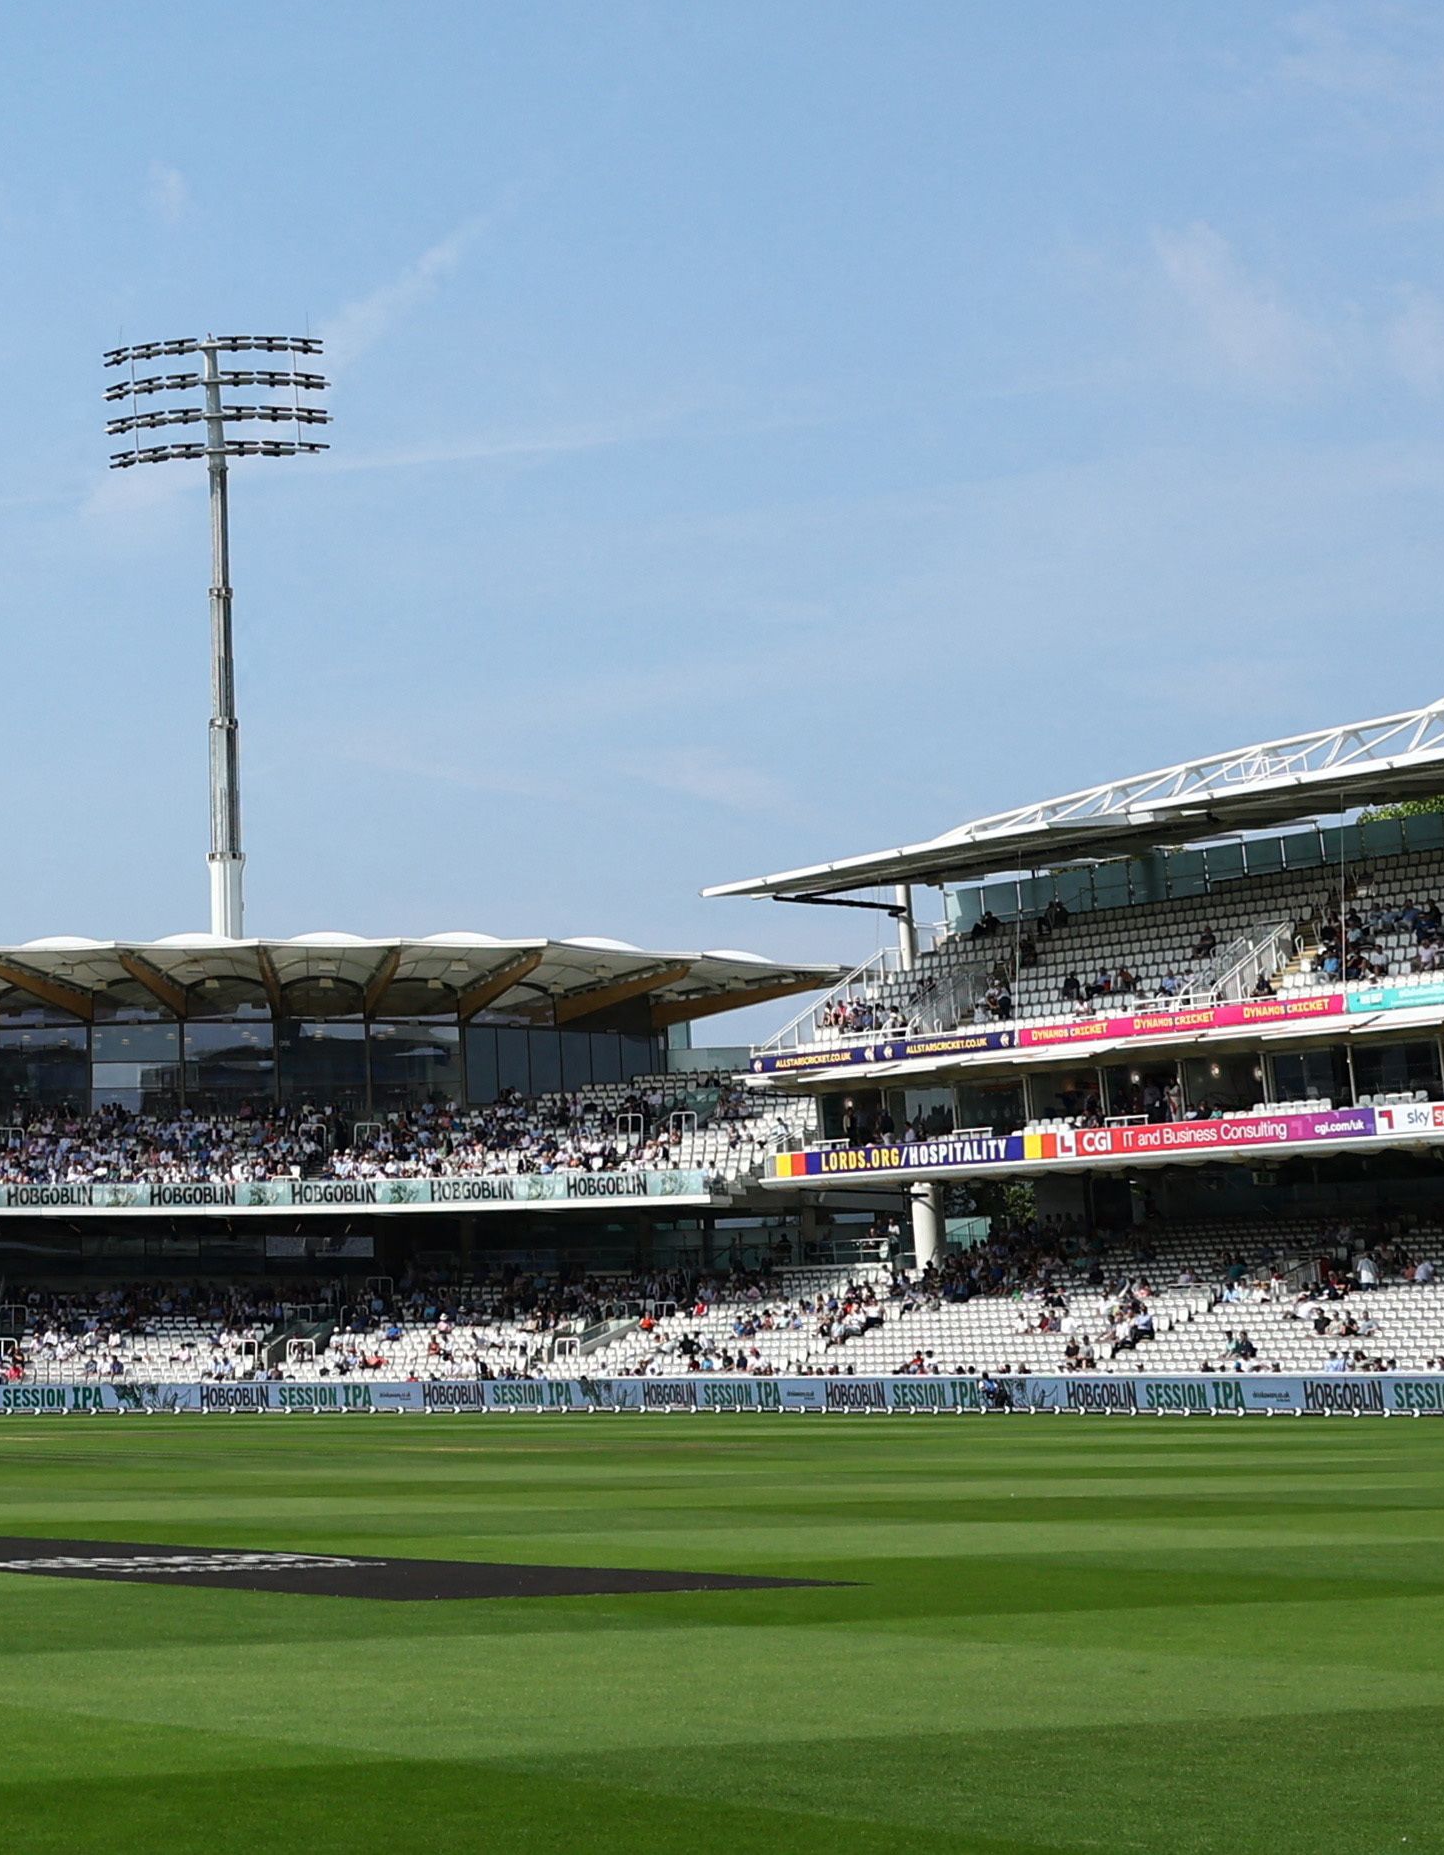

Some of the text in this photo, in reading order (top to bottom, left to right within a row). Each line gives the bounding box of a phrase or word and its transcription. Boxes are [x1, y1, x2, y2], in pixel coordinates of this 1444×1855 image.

[1243, 998, 1330, 1019] DYNAMOS CRICKET
[1134, 1011, 1215, 1030] DYNAMOS CRICKET
[1031, 1022, 1109, 1042] DYNAMOS CRICKET
[906, 1038, 987, 1055] ALLSTARSCRICKET.CO.UK
[775, 1051, 852, 1069] ALLSTARSCRICKET.CO.UK
[1407, 1108, 1430, 1126] sky
[1083, 1120, 1365, 1152] CGI IT and Business Consulting cgi.com/uk
[821, 1139, 1007, 1172] LORDS.ORG/HOSPITALITY
[7, 1186, 93, 1206] HOBGOBLIN
[150, 1184, 235, 1206] HOBGOBLIN
[291, 1183, 376, 1204] HOBGOBLIN
[430, 1180, 514, 1202] HOBGOBLIN
[567, 1173, 647, 1198] HOBGOBLIN
[3, 1388, 64, 1408] SESSION
[73, 1387, 103, 1408] IPA
[200, 1385, 268, 1408] HOBGOBLIN
[279, 1386, 337, 1406] SESSION
[343, 1385, 372, 1406] IPA
[423, 1383, 485, 1406] HOBGOBLIN
[493, 1384, 543, 1405] SESSION
[548, 1382, 573, 1405] IPA
[643, 1382, 696, 1405] HOBGOBLIN
[704, 1383, 752, 1405] SESSION
[757, 1381, 781, 1406] IPA
[825, 1381, 979, 1407] HOBGOBLIN SESSION IPA
[1065, 1381, 1137, 1408] HOBGOBLIN
[1146, 1383, 1207, 1408] SESSION
[1212, 1381, 1245, 1409] IPA
[1304, 1380, 1384, 1410] HOBGOBLIN
